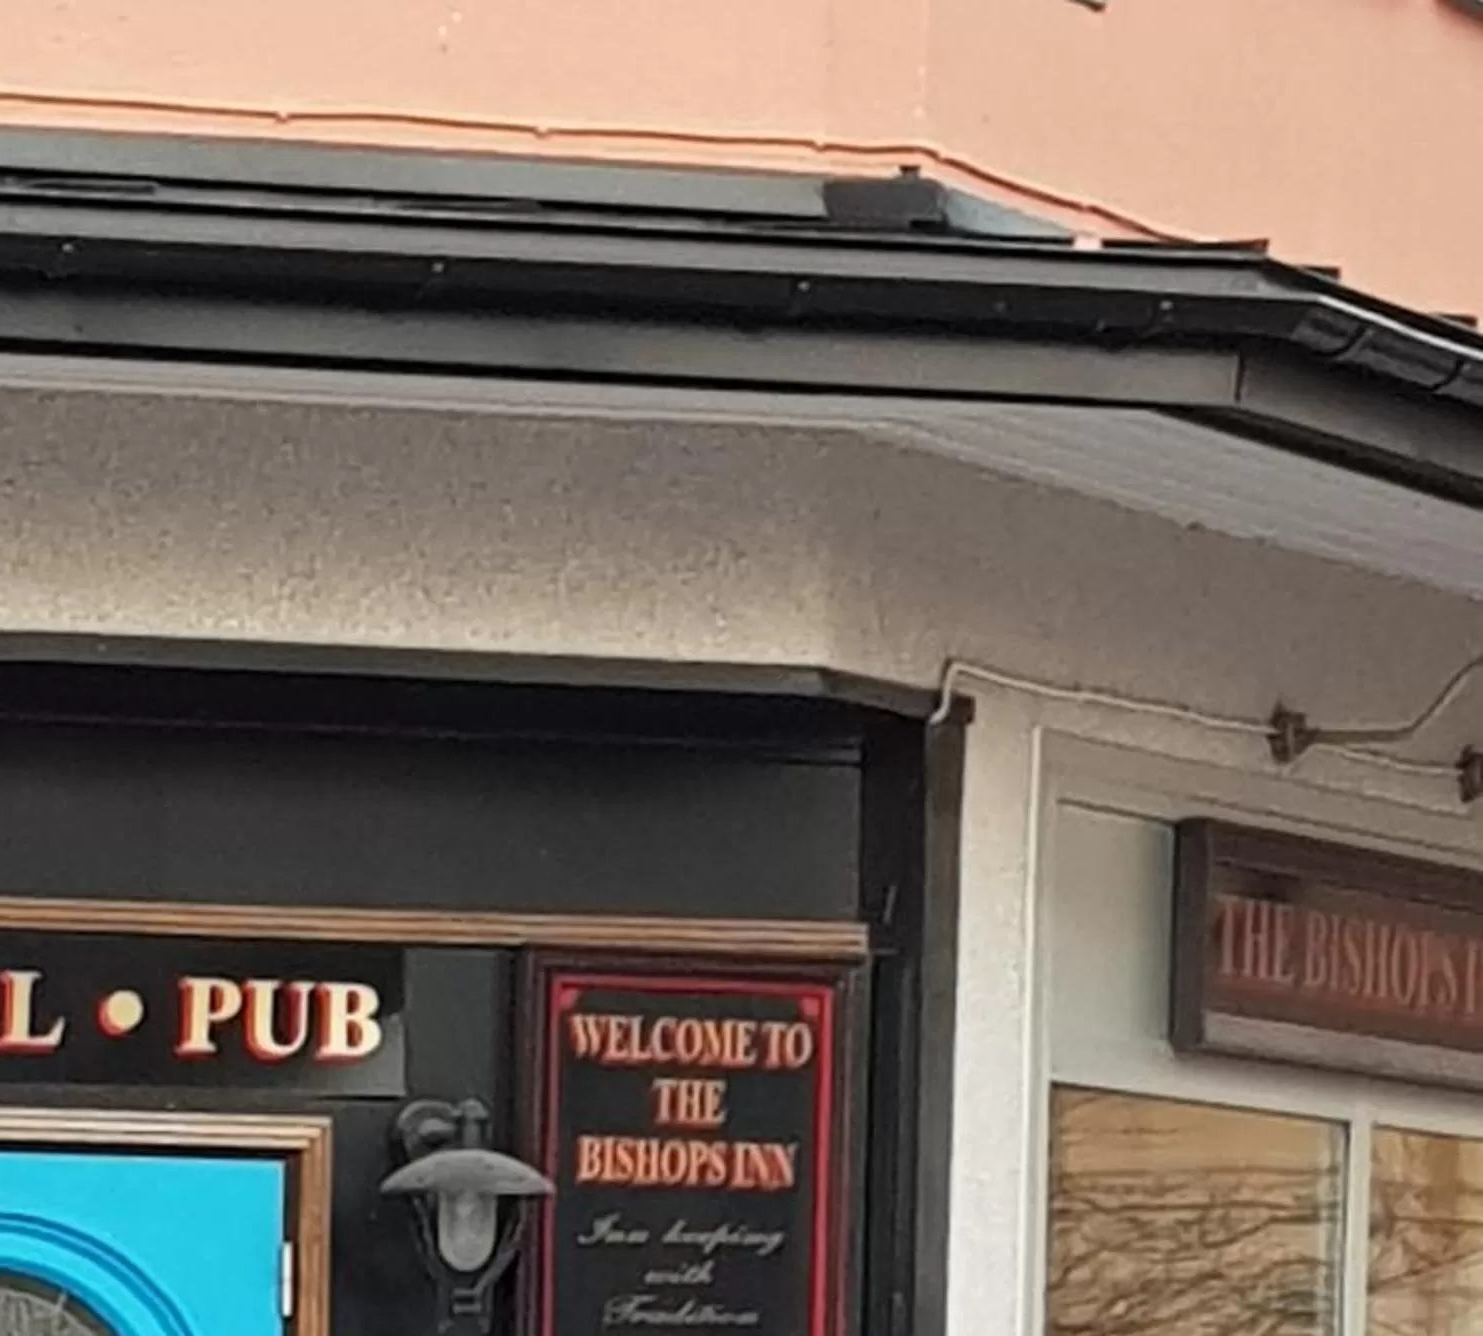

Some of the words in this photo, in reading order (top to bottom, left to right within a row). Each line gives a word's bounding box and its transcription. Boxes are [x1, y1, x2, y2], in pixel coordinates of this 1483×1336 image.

[1215, 892, 1296, 985] THE
[1302, 908, 1460, 1010] BISHOPS
[174, 975, 382, 1062] PUB
[571, 1013, 757, 1066] WELCOME
[761, 1021, 813, 1068] TO
[651, 1077, 727, 1126] THE
[574, 1135, 727, 1186] BISHOPS
[729, 1141, 799, 1188] INN
[643, 1259, 714, 1285] with
